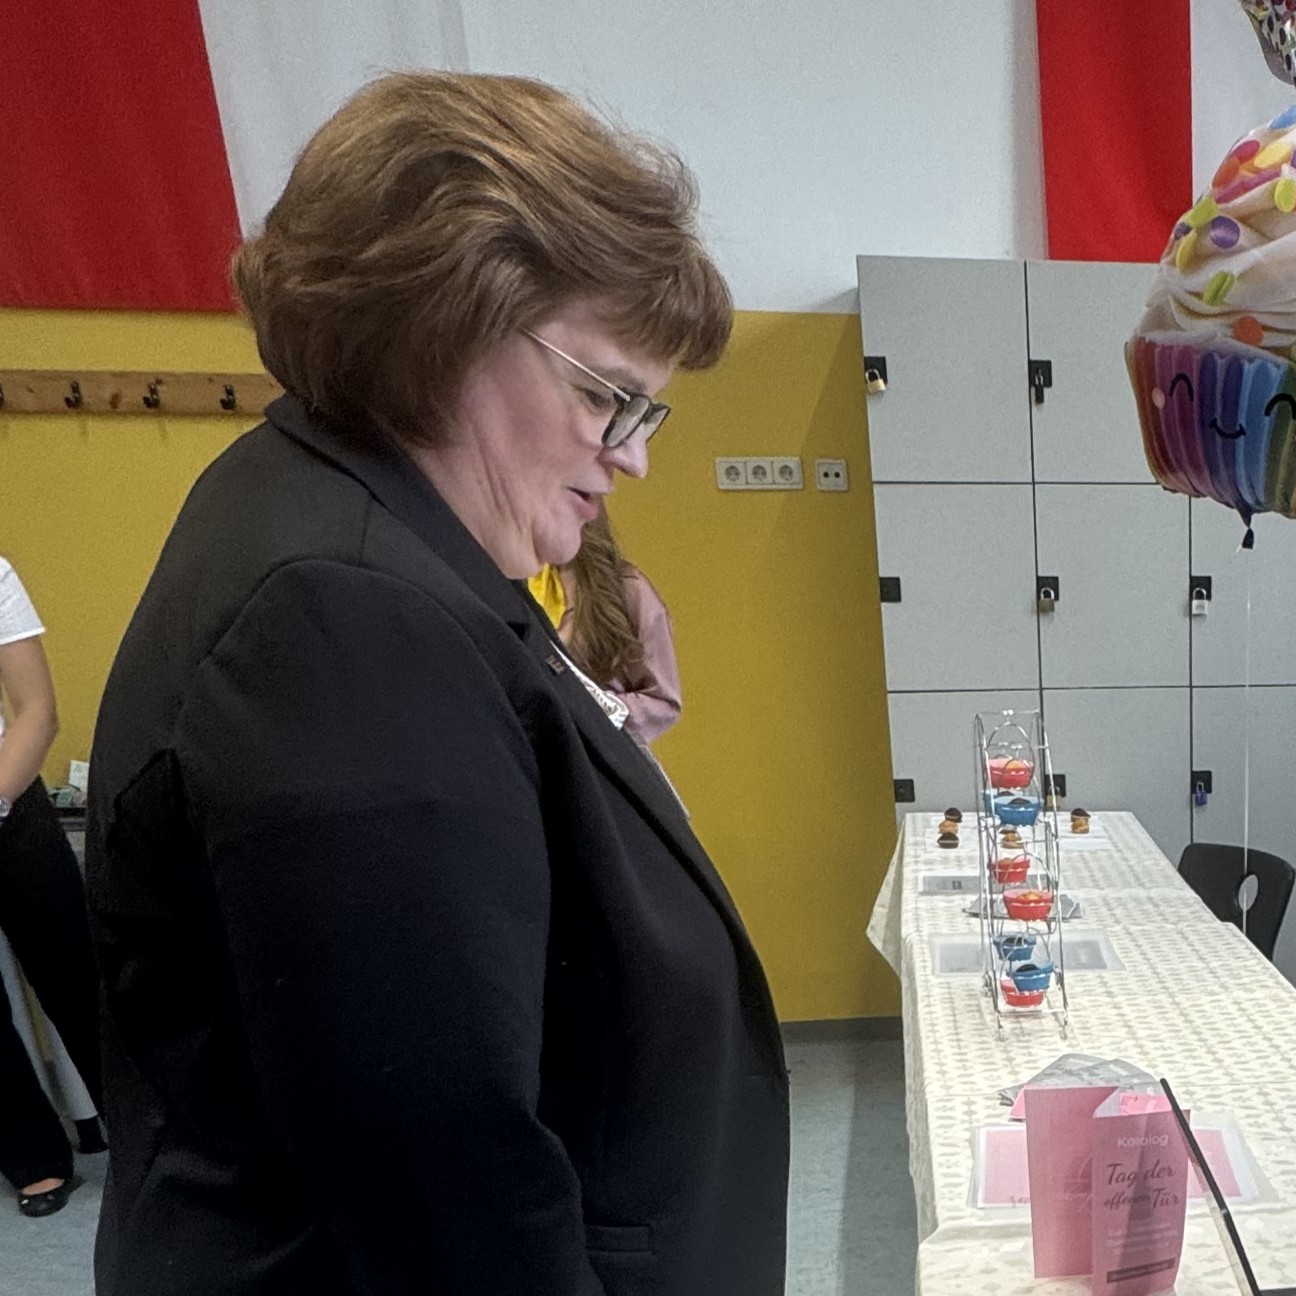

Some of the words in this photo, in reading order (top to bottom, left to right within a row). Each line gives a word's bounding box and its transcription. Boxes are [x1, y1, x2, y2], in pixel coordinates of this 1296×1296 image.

[1118, 1134, 1168, 1147] Katalog
[1107, 1163, 1137, 1188] Tag
[1144, 1160, 1176, 1180] der
[1152, 1187, 1180, 1209] Tür
